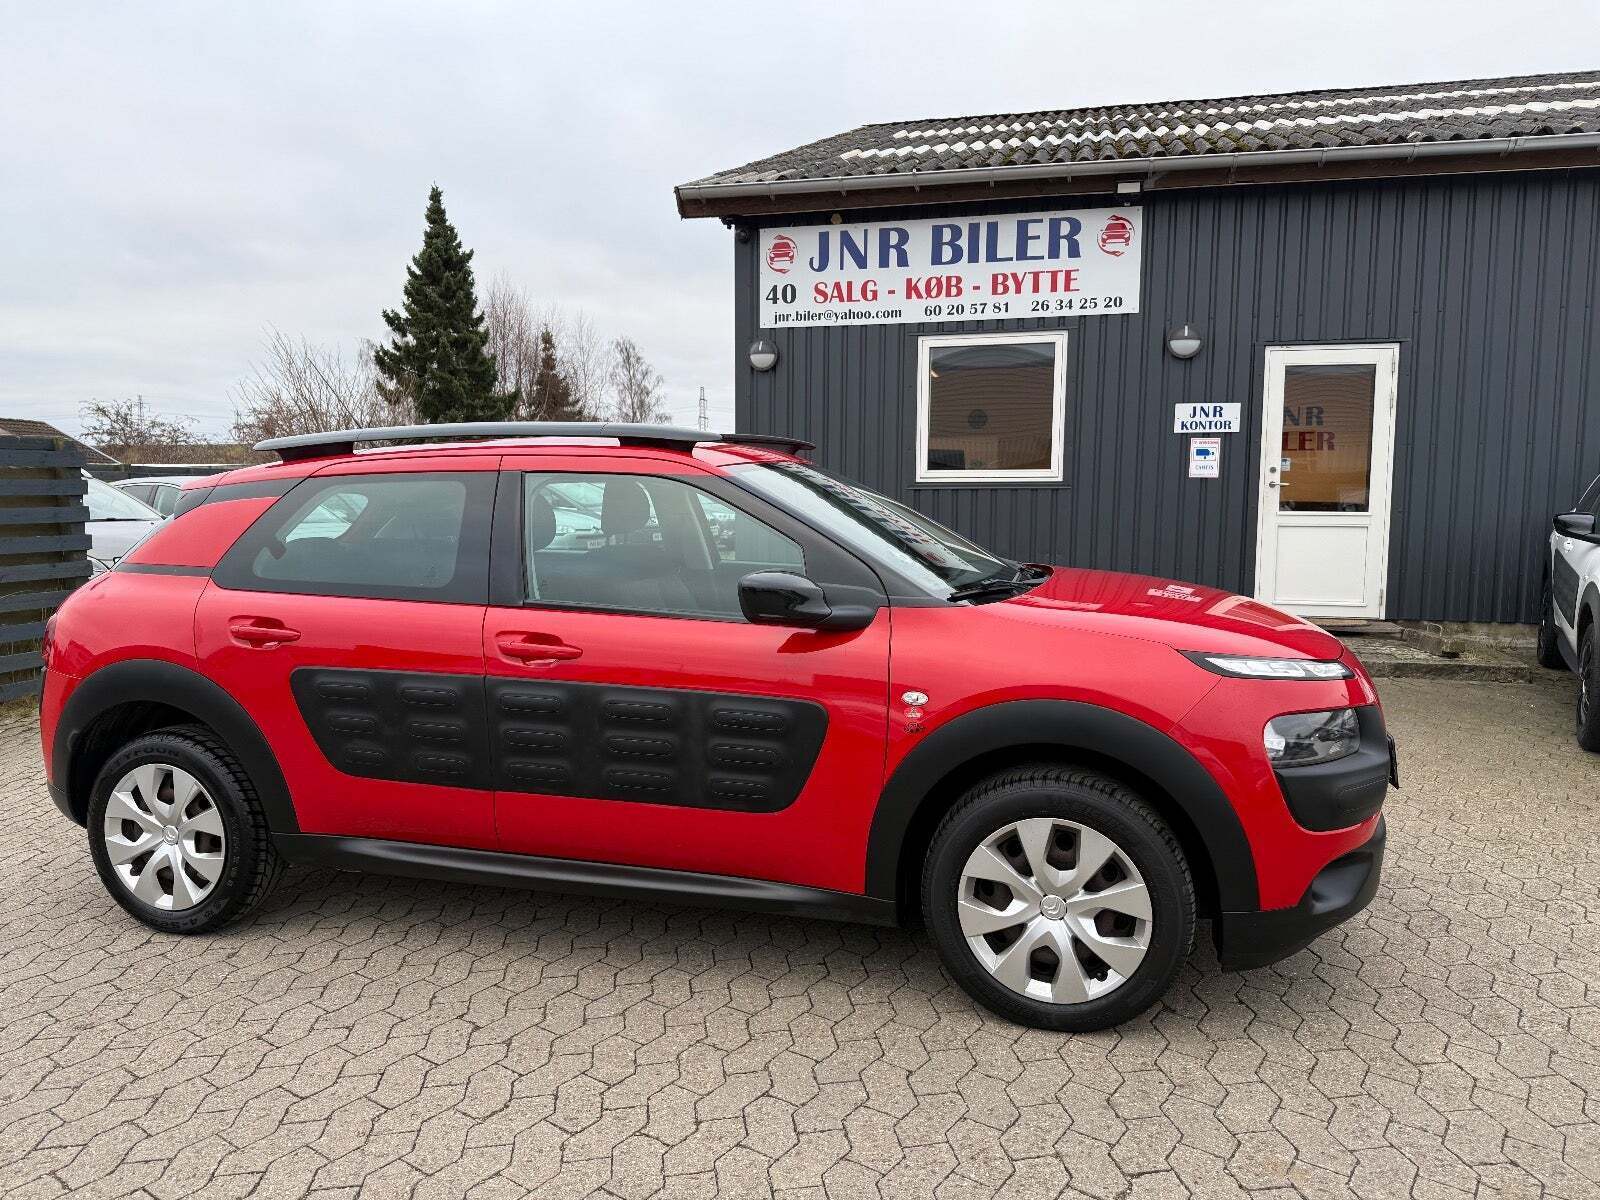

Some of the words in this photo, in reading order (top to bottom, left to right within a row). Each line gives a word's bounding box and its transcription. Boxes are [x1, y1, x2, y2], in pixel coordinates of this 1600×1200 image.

[808, 227, 910, 273] JNR
[931, 217, 1081, 266] BILER
[765, 283, 797, 305] 40
[813, 279, 878, 304] SALG
[905, 274, 963, 300] KØB
[991, 268, 1080, 296] BYTTE
[924, 305, 942, 317] 60
[946, 303, 965, 316] 20
[969, 302, 987, 315] 57
[992, 301, 1009, 313] 81
[1031, 299, 1049, 312] 26
[1054, 298, 1074, 311] 34
[1079, 297, 1097, 310] 25
[1103, 296, 1123, 309] 20
[774, 308, 902, 325] jnr.biler@yahoo.com
[1190, 405, 1223, 418] JNR
[1283, 406, 1324, 426] NR
[1181, 420, 1232, 430] KONTOR
[1282, 431, 1335, 451] LER
